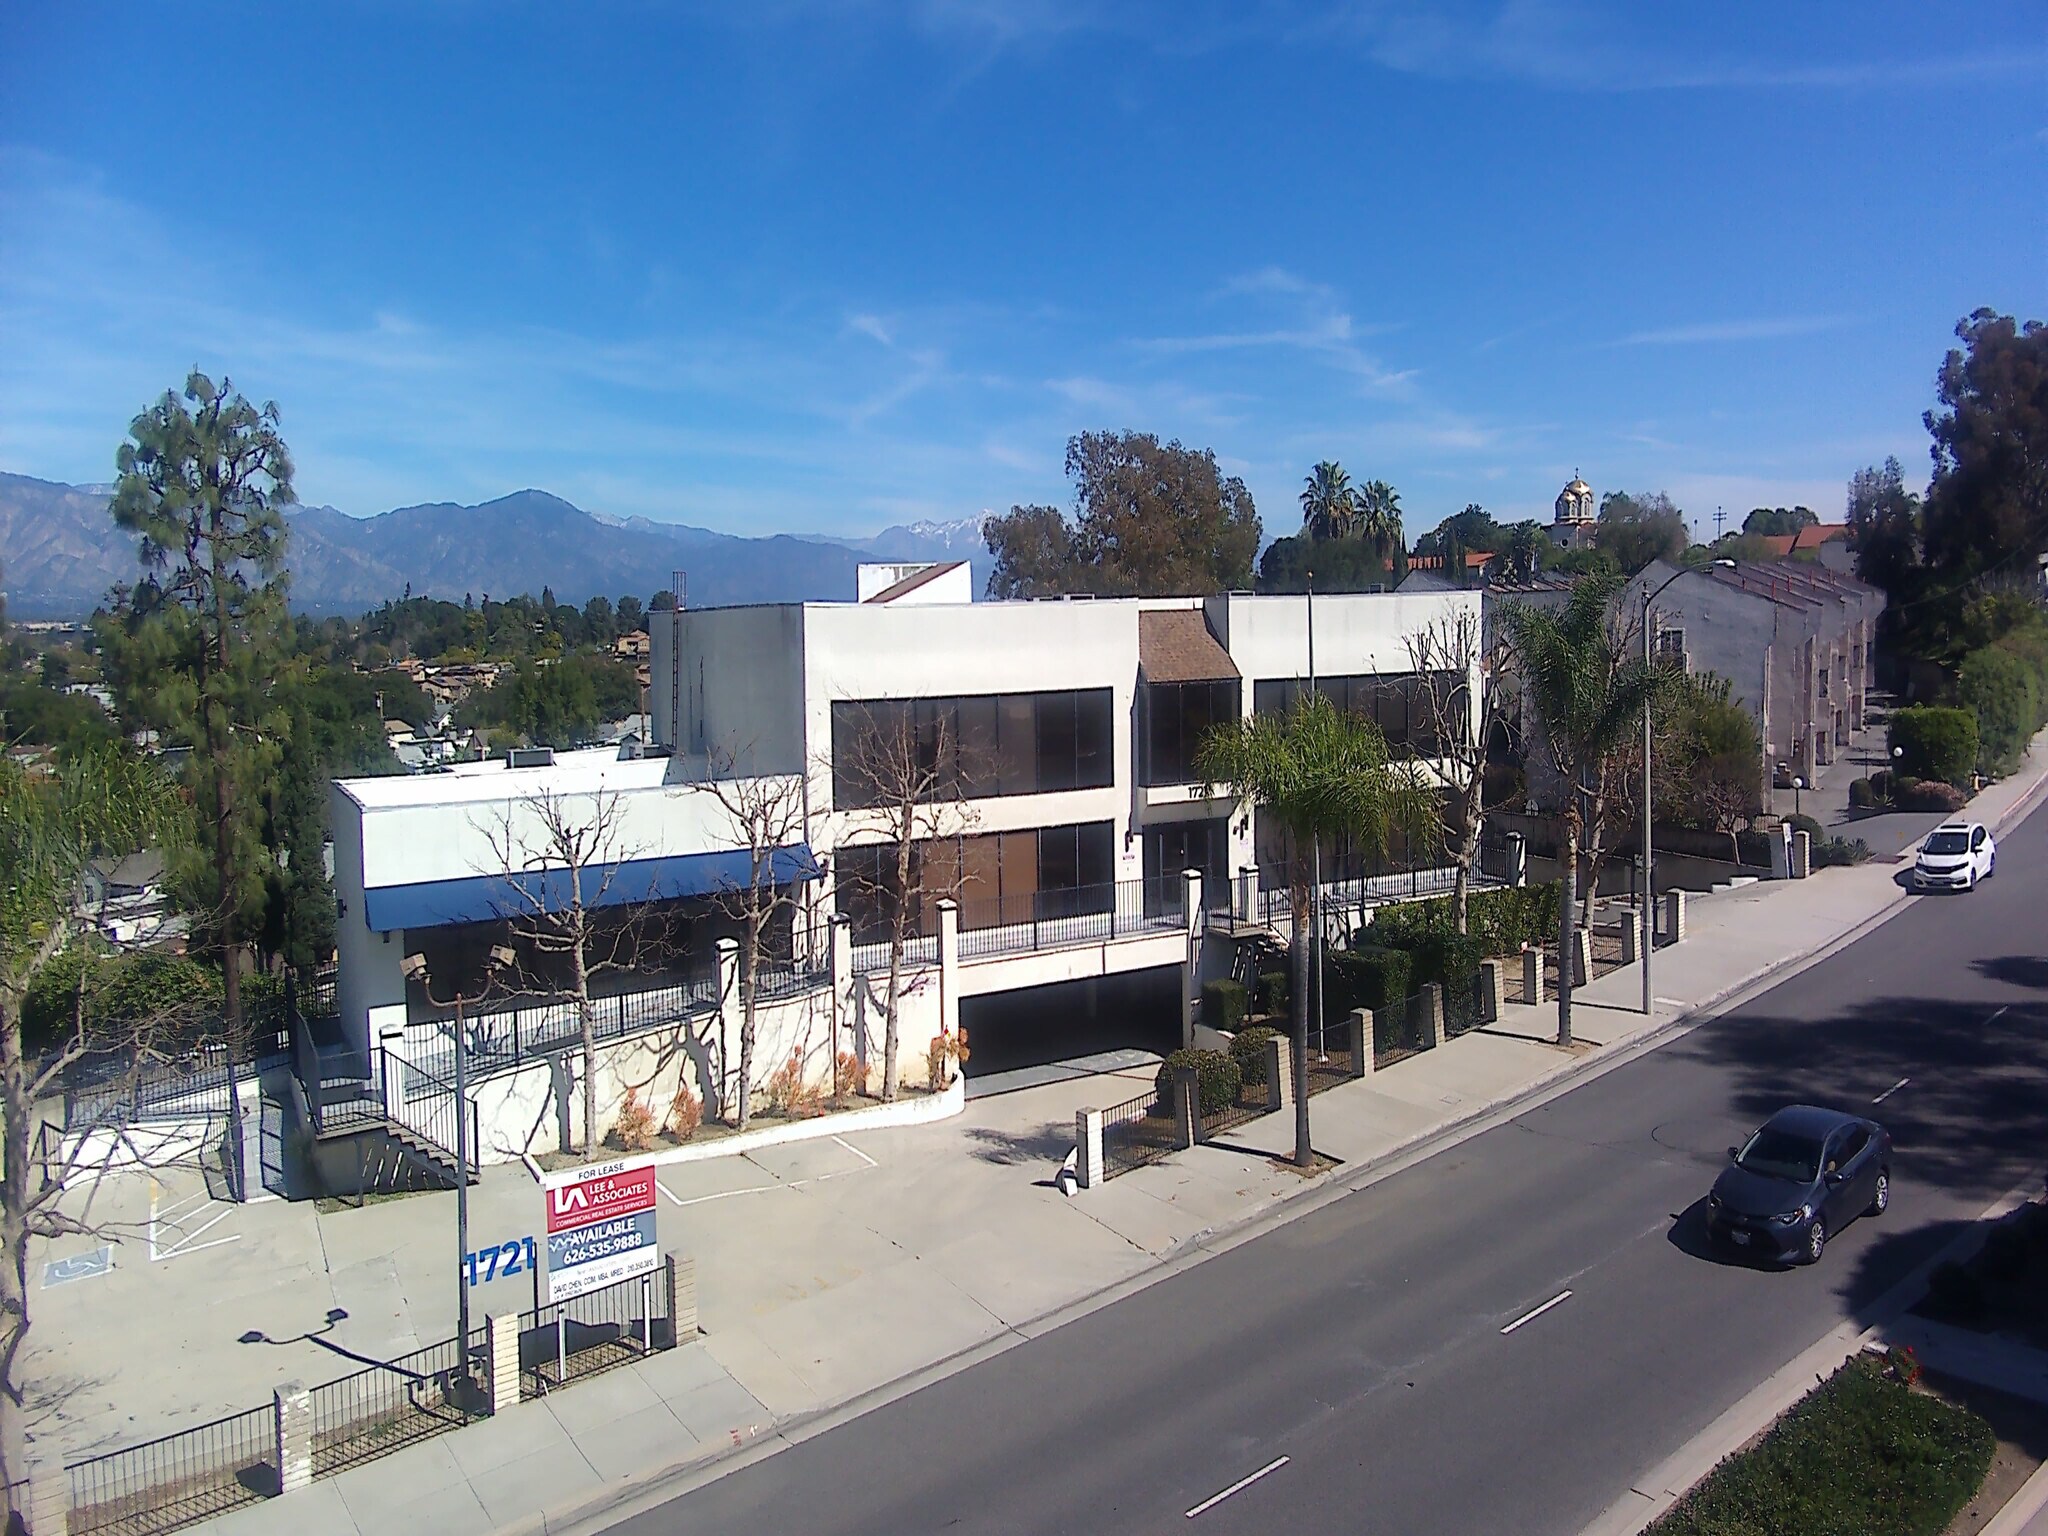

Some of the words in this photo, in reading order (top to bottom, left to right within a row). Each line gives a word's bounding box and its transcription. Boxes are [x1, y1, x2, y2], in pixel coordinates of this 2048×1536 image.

[578, 1169, 596, 1180] FOR
[598, 1163, 624, 1176] LEASE
[589, 1182, 606, 1195] LEE
[608, 1180, 616, 1190] &
[592, 1182, 648, 1205] ASSOCIATES
[555, 1213, 592, 1228] COMMERCIAL
[591, 1210, 605, 1220] REAL
[605, 1205, 624, 1216] ESTATE
[624, 1200, 648, 1211] SERVICES
[569, 1218, 636, 1246] AVAILABLE
[464, 1236, 533, 1286] 1721
[563, 1233, 642, 1265] 626-535-9888
